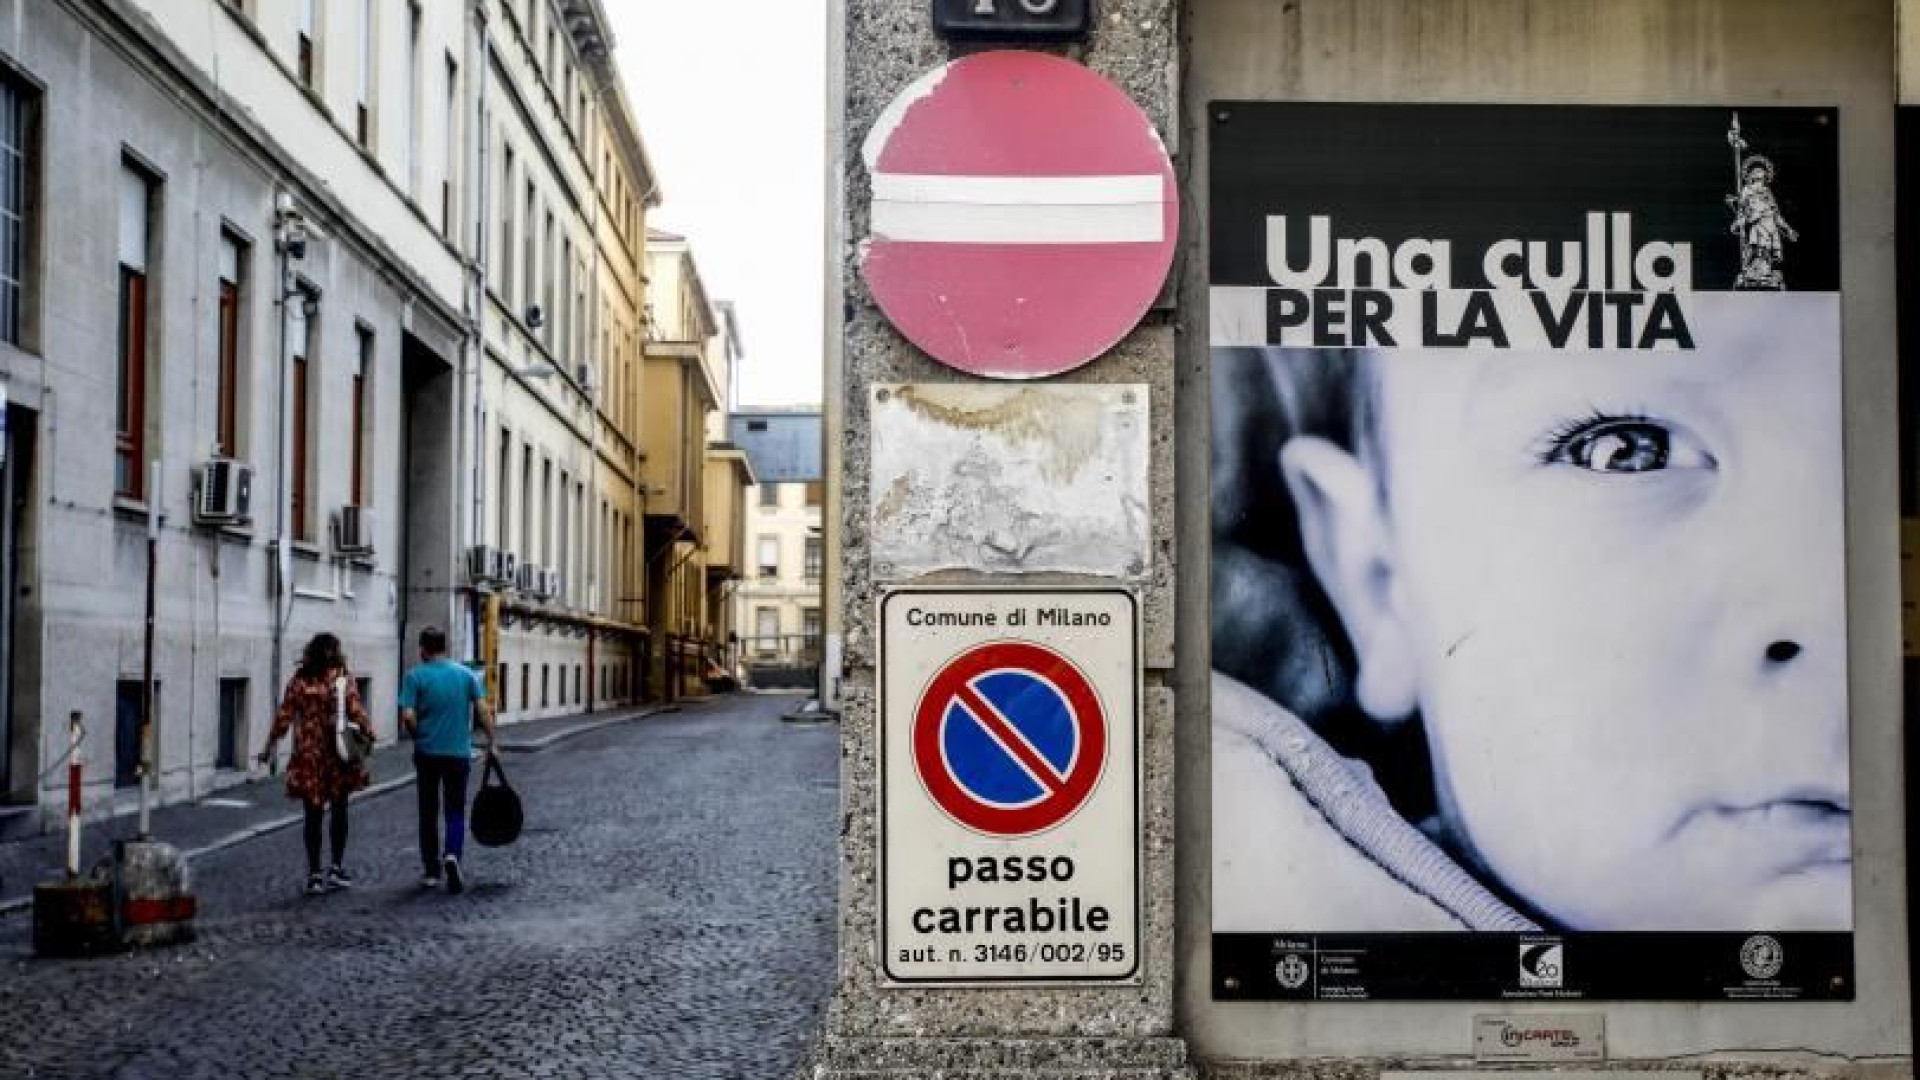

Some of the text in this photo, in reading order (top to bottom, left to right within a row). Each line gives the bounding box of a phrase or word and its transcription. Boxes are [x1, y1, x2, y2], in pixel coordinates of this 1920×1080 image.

[1266, 211, 1693, 291] Una culla
[1266, 288, 1696, 349] PER LA VITA
[906, 607, 1111, 626] Comune di Milano
[949, 855, 1075, 890] passo
[911, 897, 1110, 934] carrabile
[899, 943, 1126, 964] aut. n. 3146/002/95
